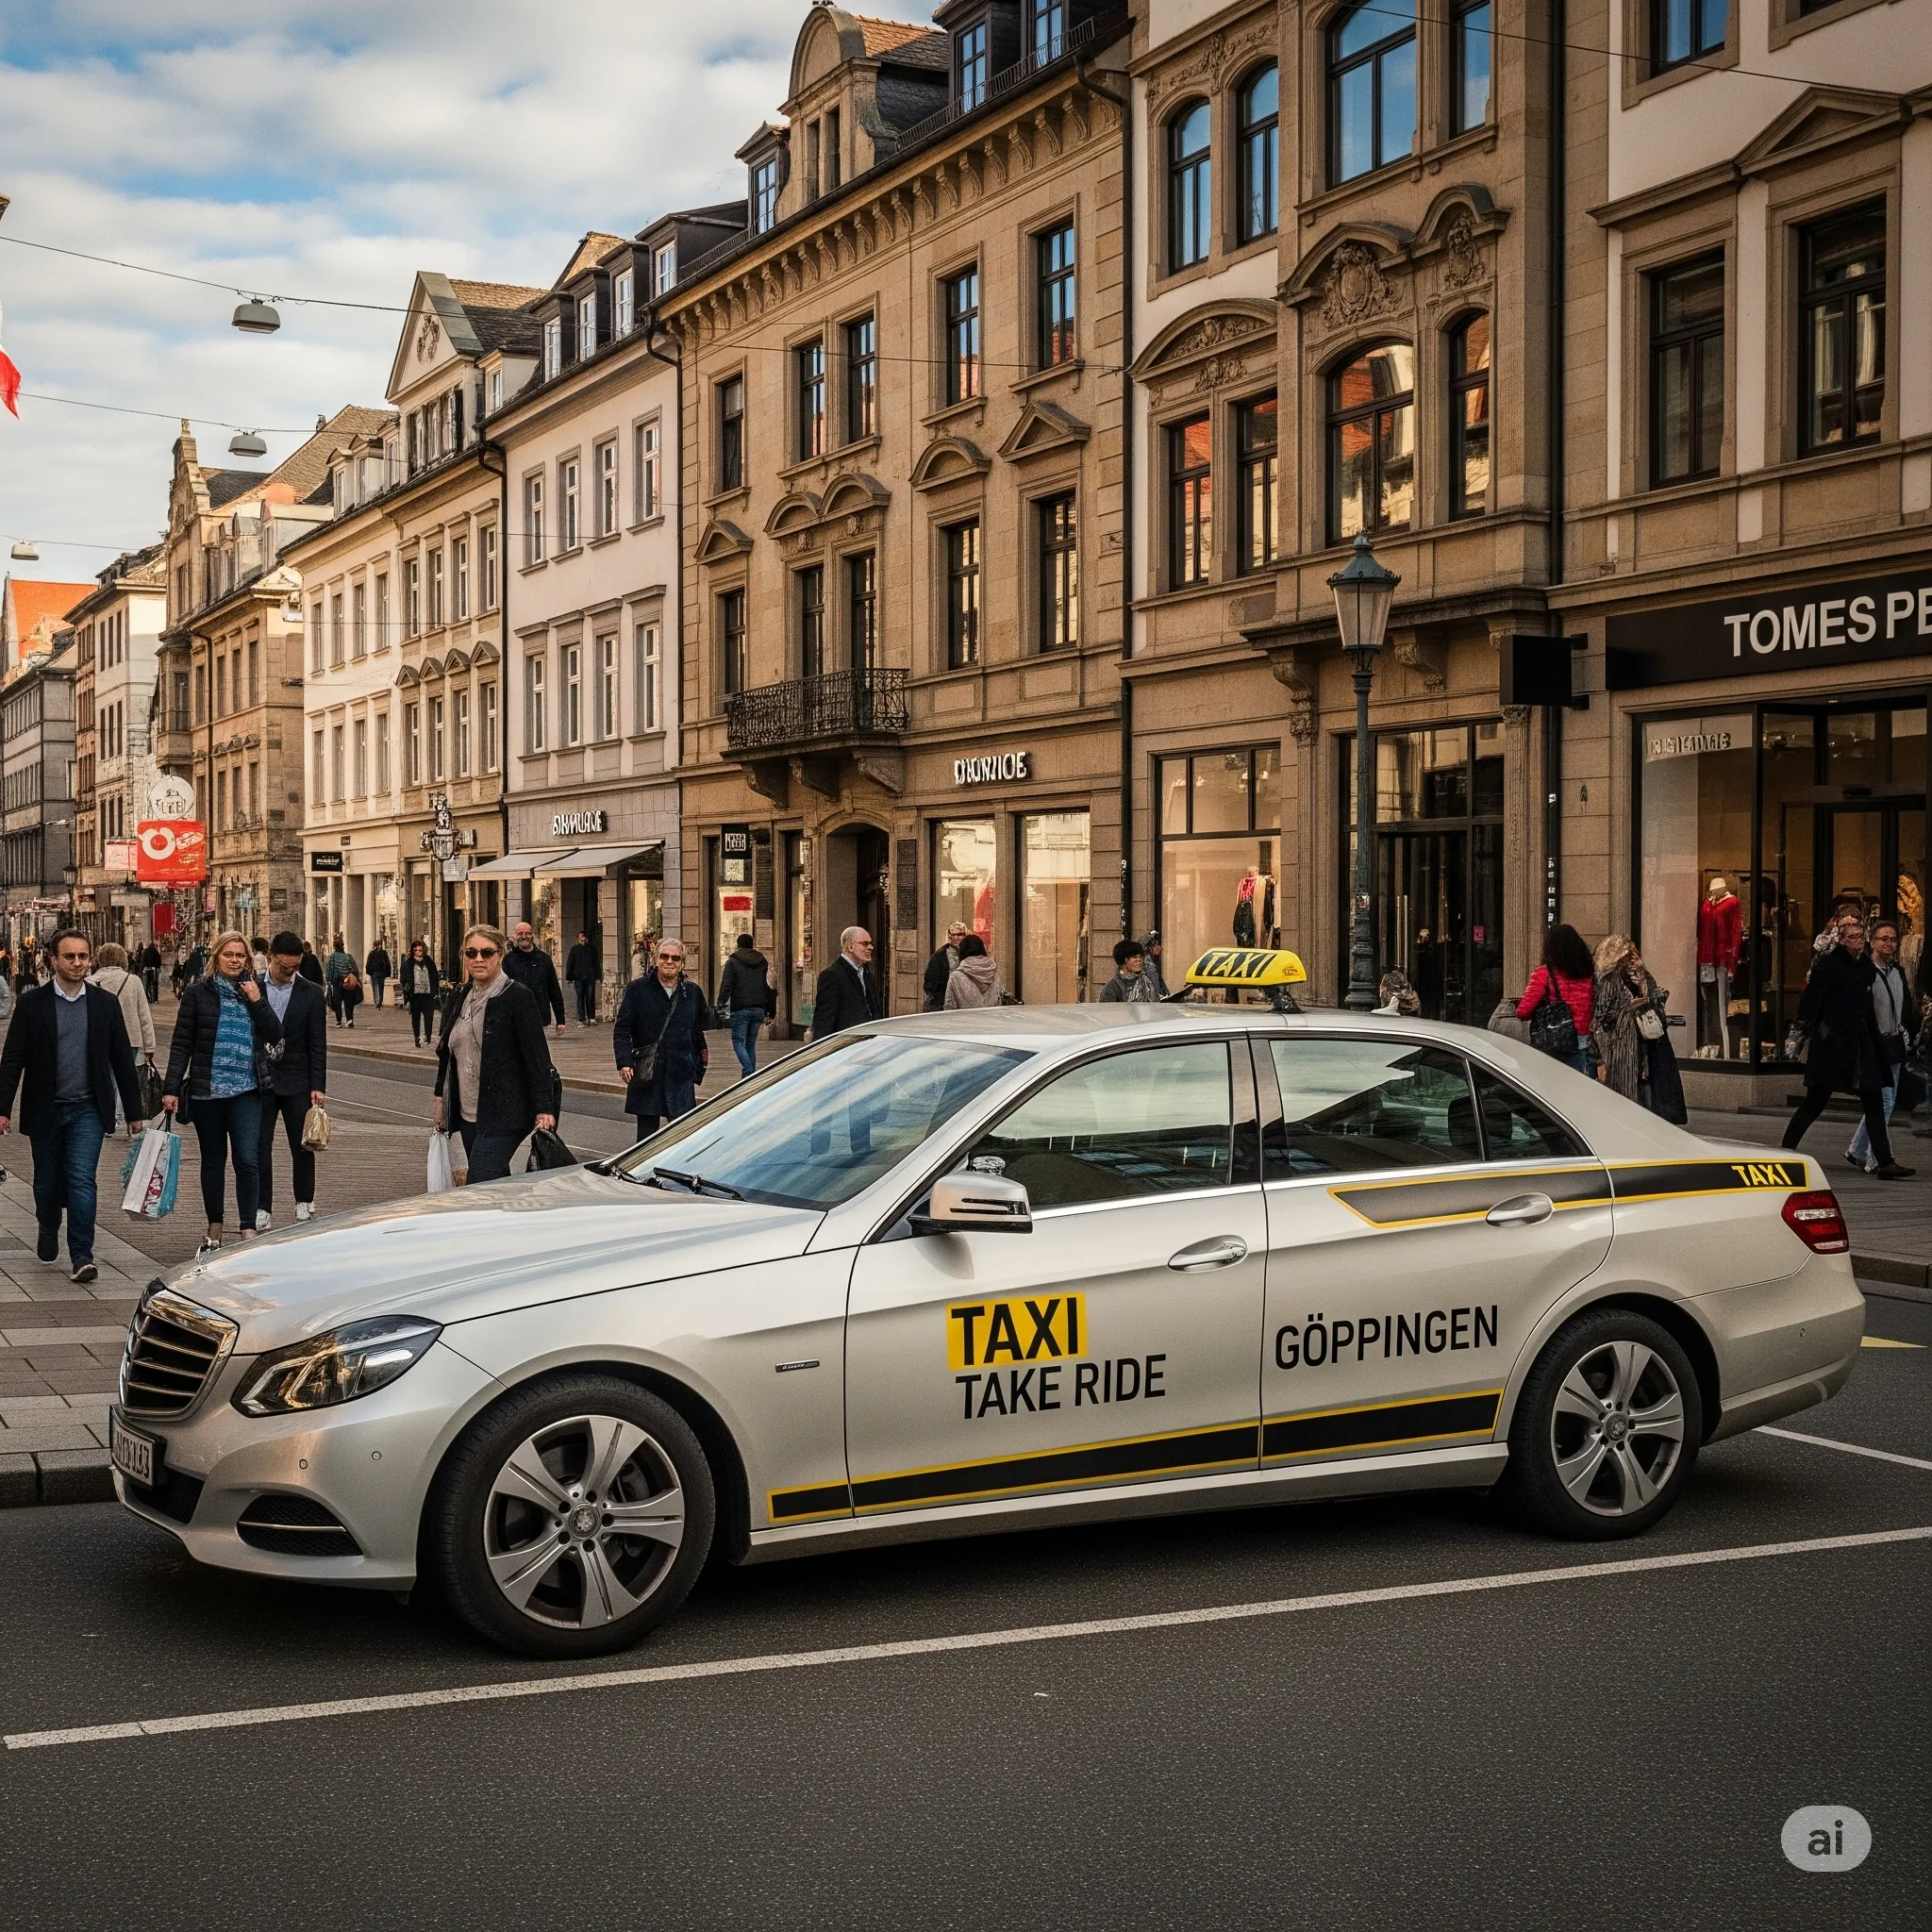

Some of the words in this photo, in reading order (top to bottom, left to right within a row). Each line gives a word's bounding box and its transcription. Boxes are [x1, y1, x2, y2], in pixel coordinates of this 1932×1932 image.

[1724, 595, 1876, 658] TOMES
[1202, 952, 1275, 978] TAXI
[1730, 1163, 1793, 1187] TAXI
[951, 1296, 1078, 1366] TAXI
[1274, 1304, 1498, 1370] GÖPPINGEN
[955, 1365, 1062, 1420] TAKE
[1074, 1353, 1167, 1407] RIDE
